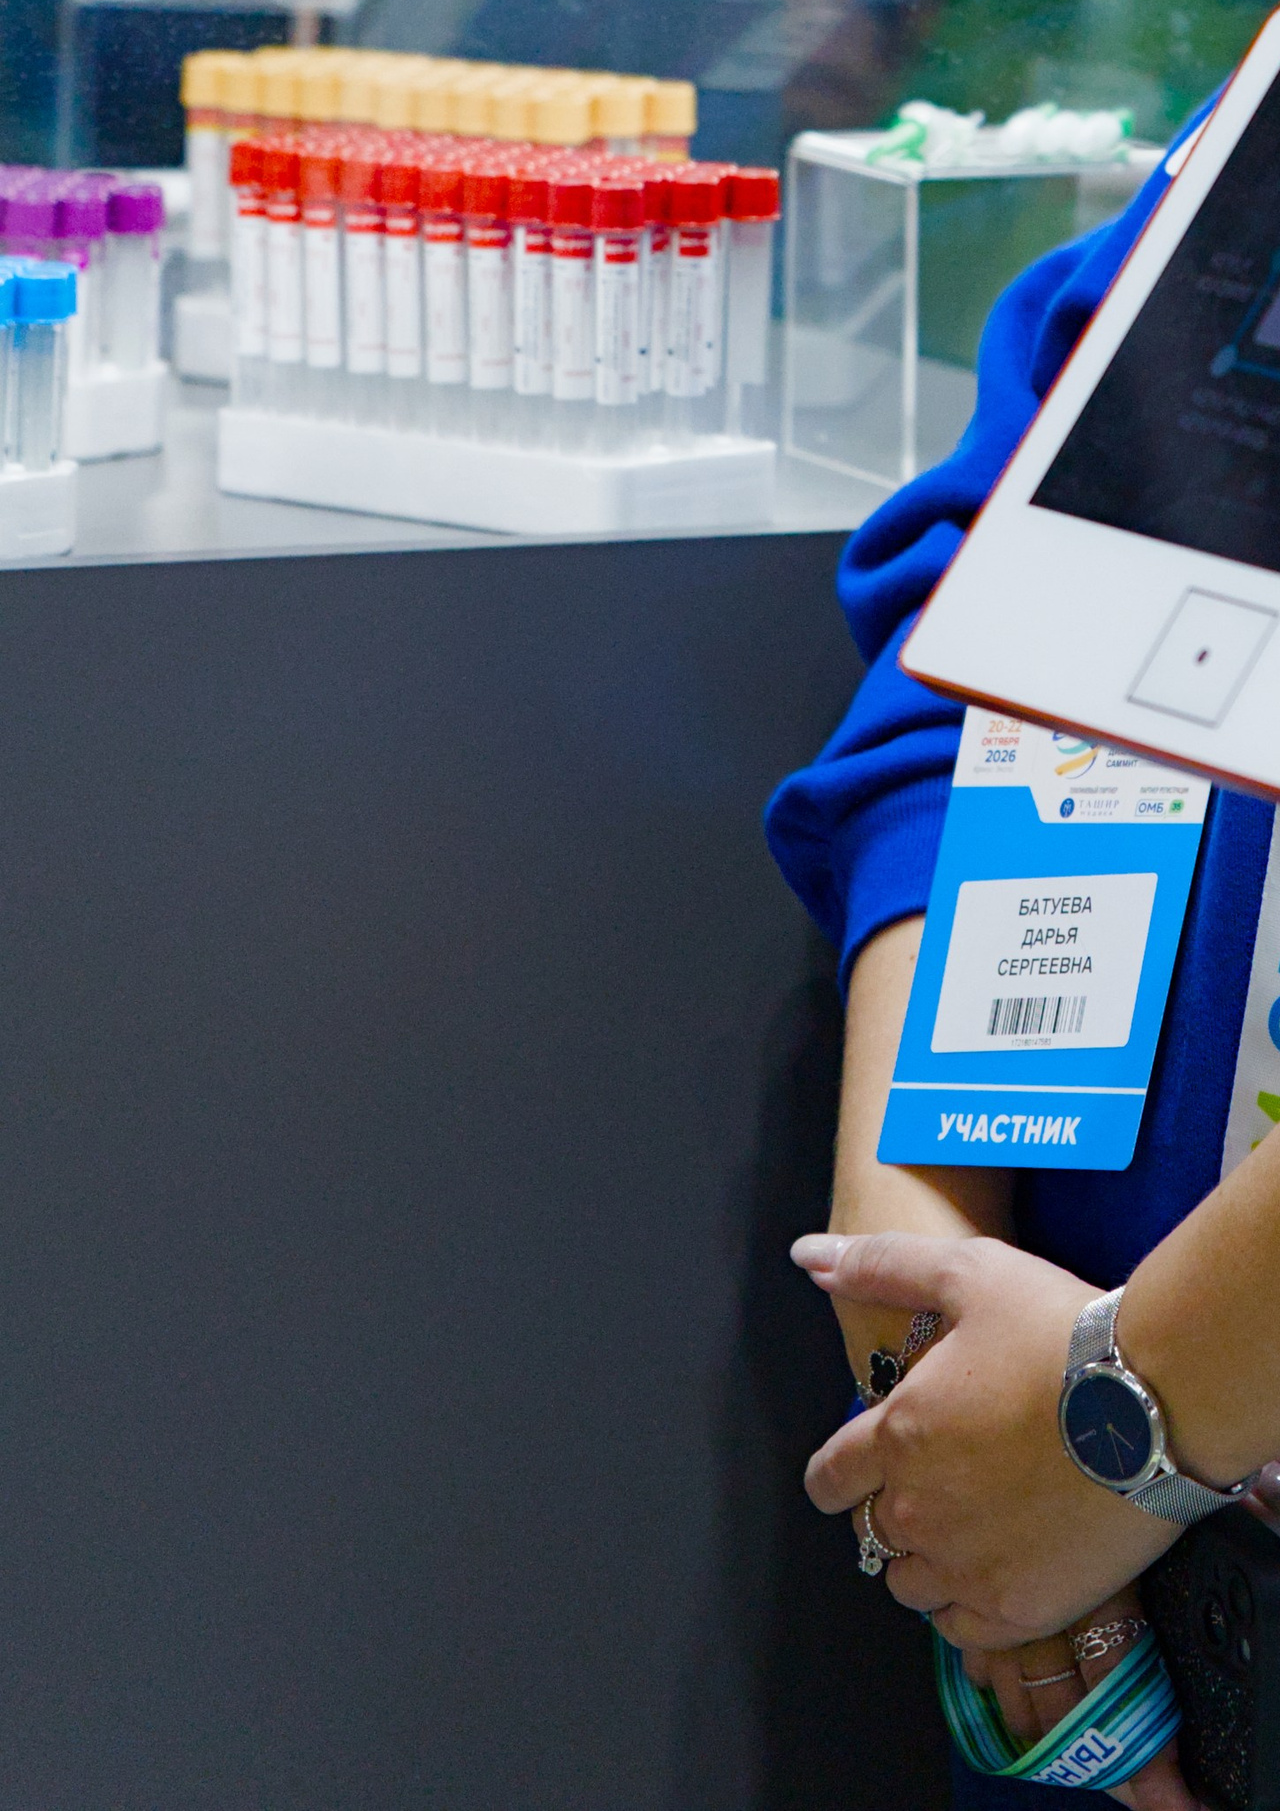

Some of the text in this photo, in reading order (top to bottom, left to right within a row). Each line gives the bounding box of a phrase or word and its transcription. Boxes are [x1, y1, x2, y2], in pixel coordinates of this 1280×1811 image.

[988, 720, 1022, 733] 20-22
[982, 737, 1020, 746] ОКТЯБРЯ
[985, 750, 1016, 763] 2026
[1106, 759, 1139, 768] САММИТ
[1078, 799, 1120, 809] ТАШИР
[1138, 802, 1164, 814] ОМБ
[1018, 896, 1093, 917] БАТУЕВА
[1021, 926, 1078, 949] ДАРЬЯ
[997, 956, 1093, 977] СЕРГЕЕВНА
[937, 1112, 1082, 1145] УЧАСТНИК
